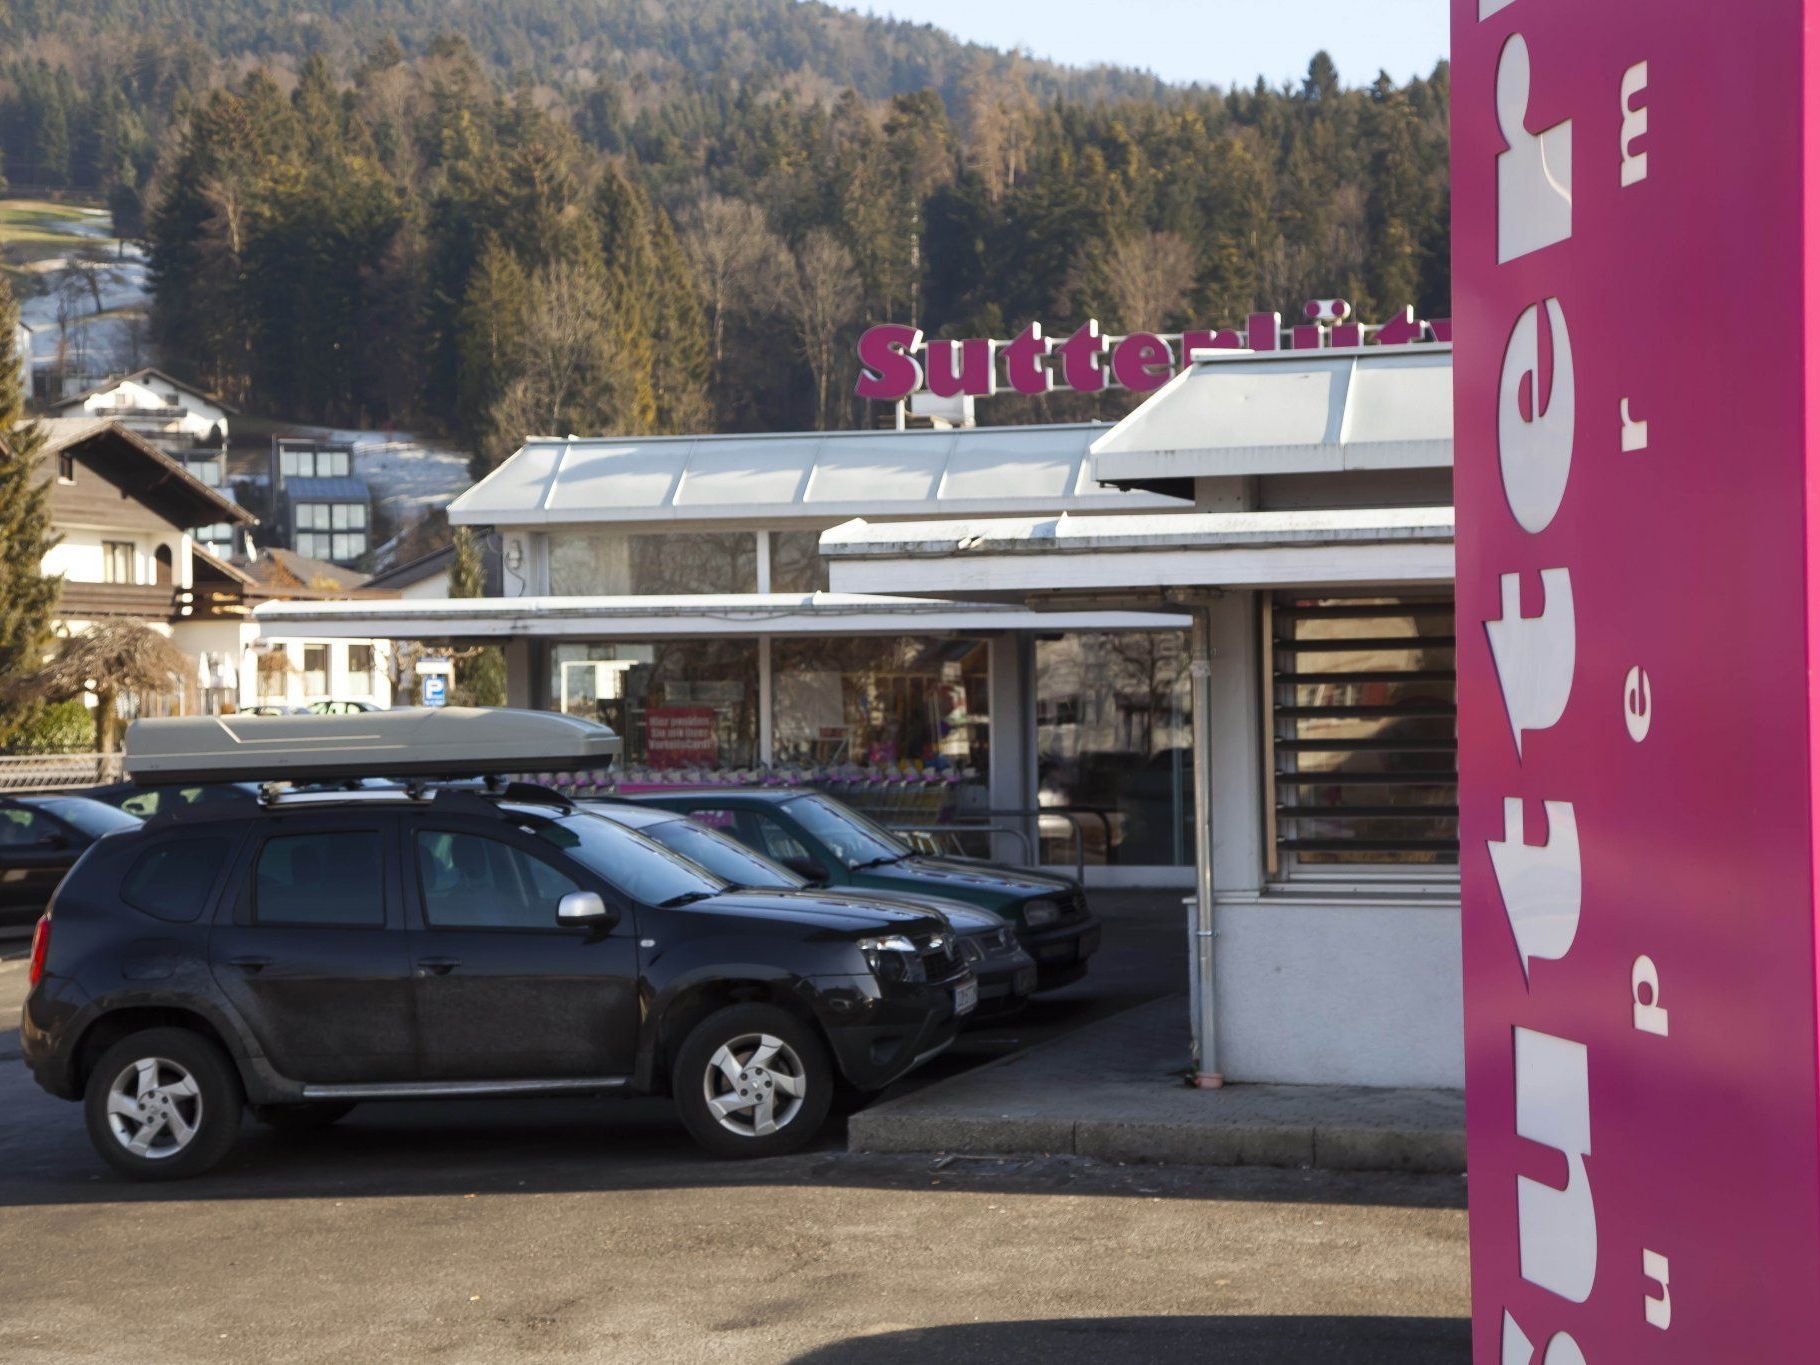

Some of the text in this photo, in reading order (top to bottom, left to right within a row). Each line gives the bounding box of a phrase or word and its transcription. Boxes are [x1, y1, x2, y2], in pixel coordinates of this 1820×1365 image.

[855, 298, 1453, 399] Sutte
[425, 679, 444, 699] P
[1479, 0, 1597, 1365] utter
